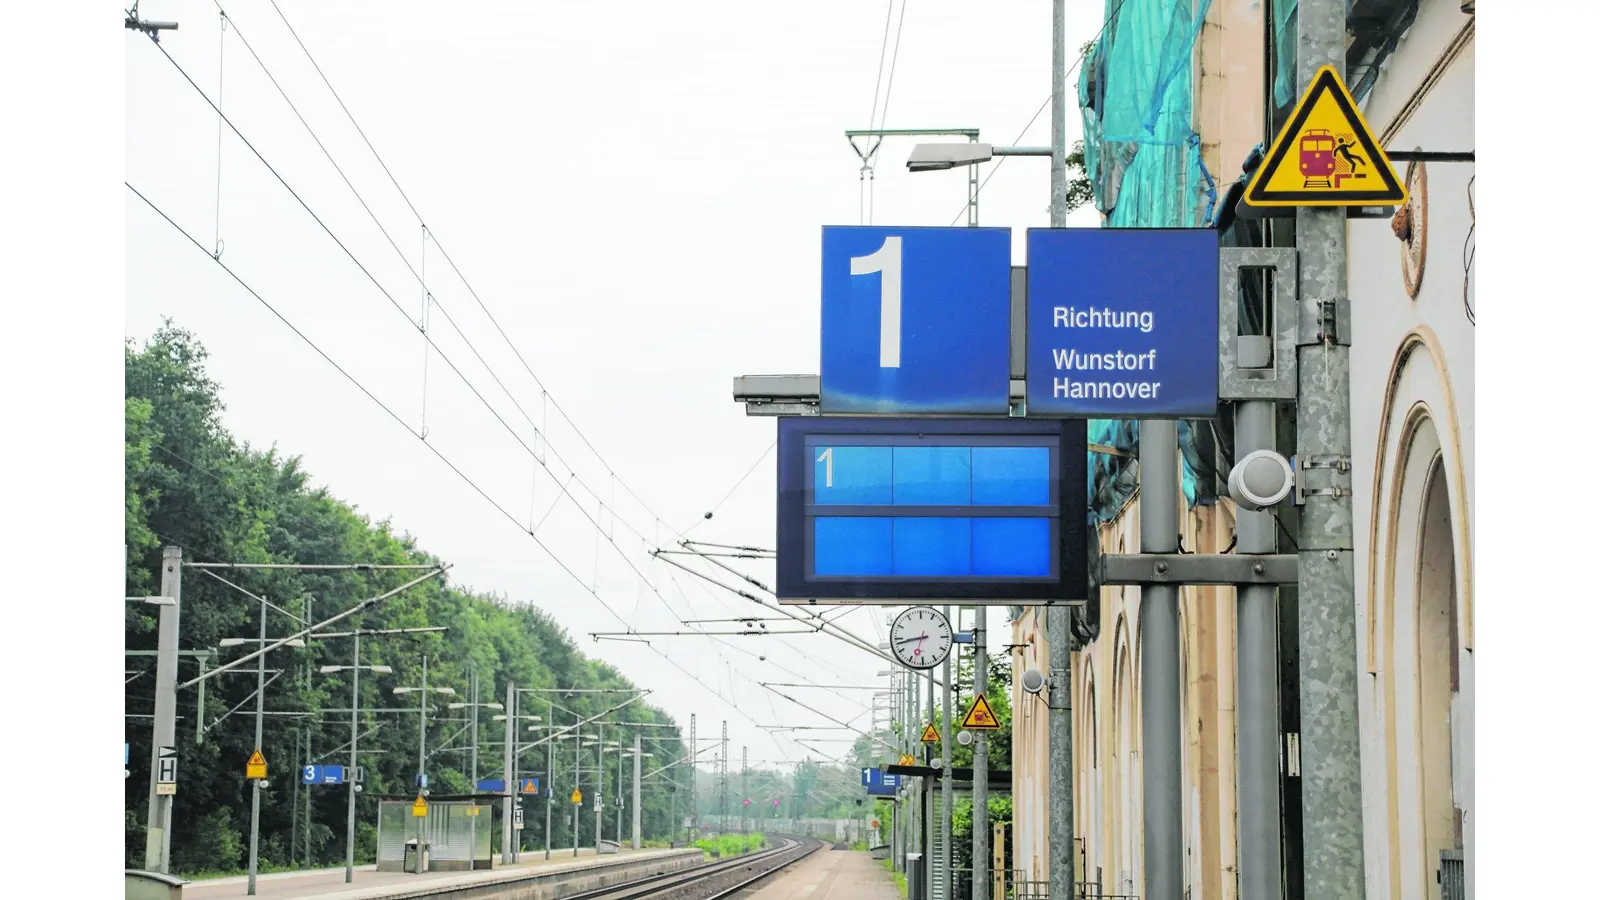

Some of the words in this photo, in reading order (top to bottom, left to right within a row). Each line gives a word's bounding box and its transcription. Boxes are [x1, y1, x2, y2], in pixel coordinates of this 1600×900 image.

[850, 236, 903, 368] 1
[1053, 306, 1153, 333] Richtung
[1052, 349, 1156, 370] Wunstorf
[1053, 377, 1161, 399] Hannover
[816, 447, 833, 487] 1
[160, 760, 174, 781] H
[304, 765, 315, 780] 3
[864, 768, 871, 783] 1
[515, 811, 522, 822] H
